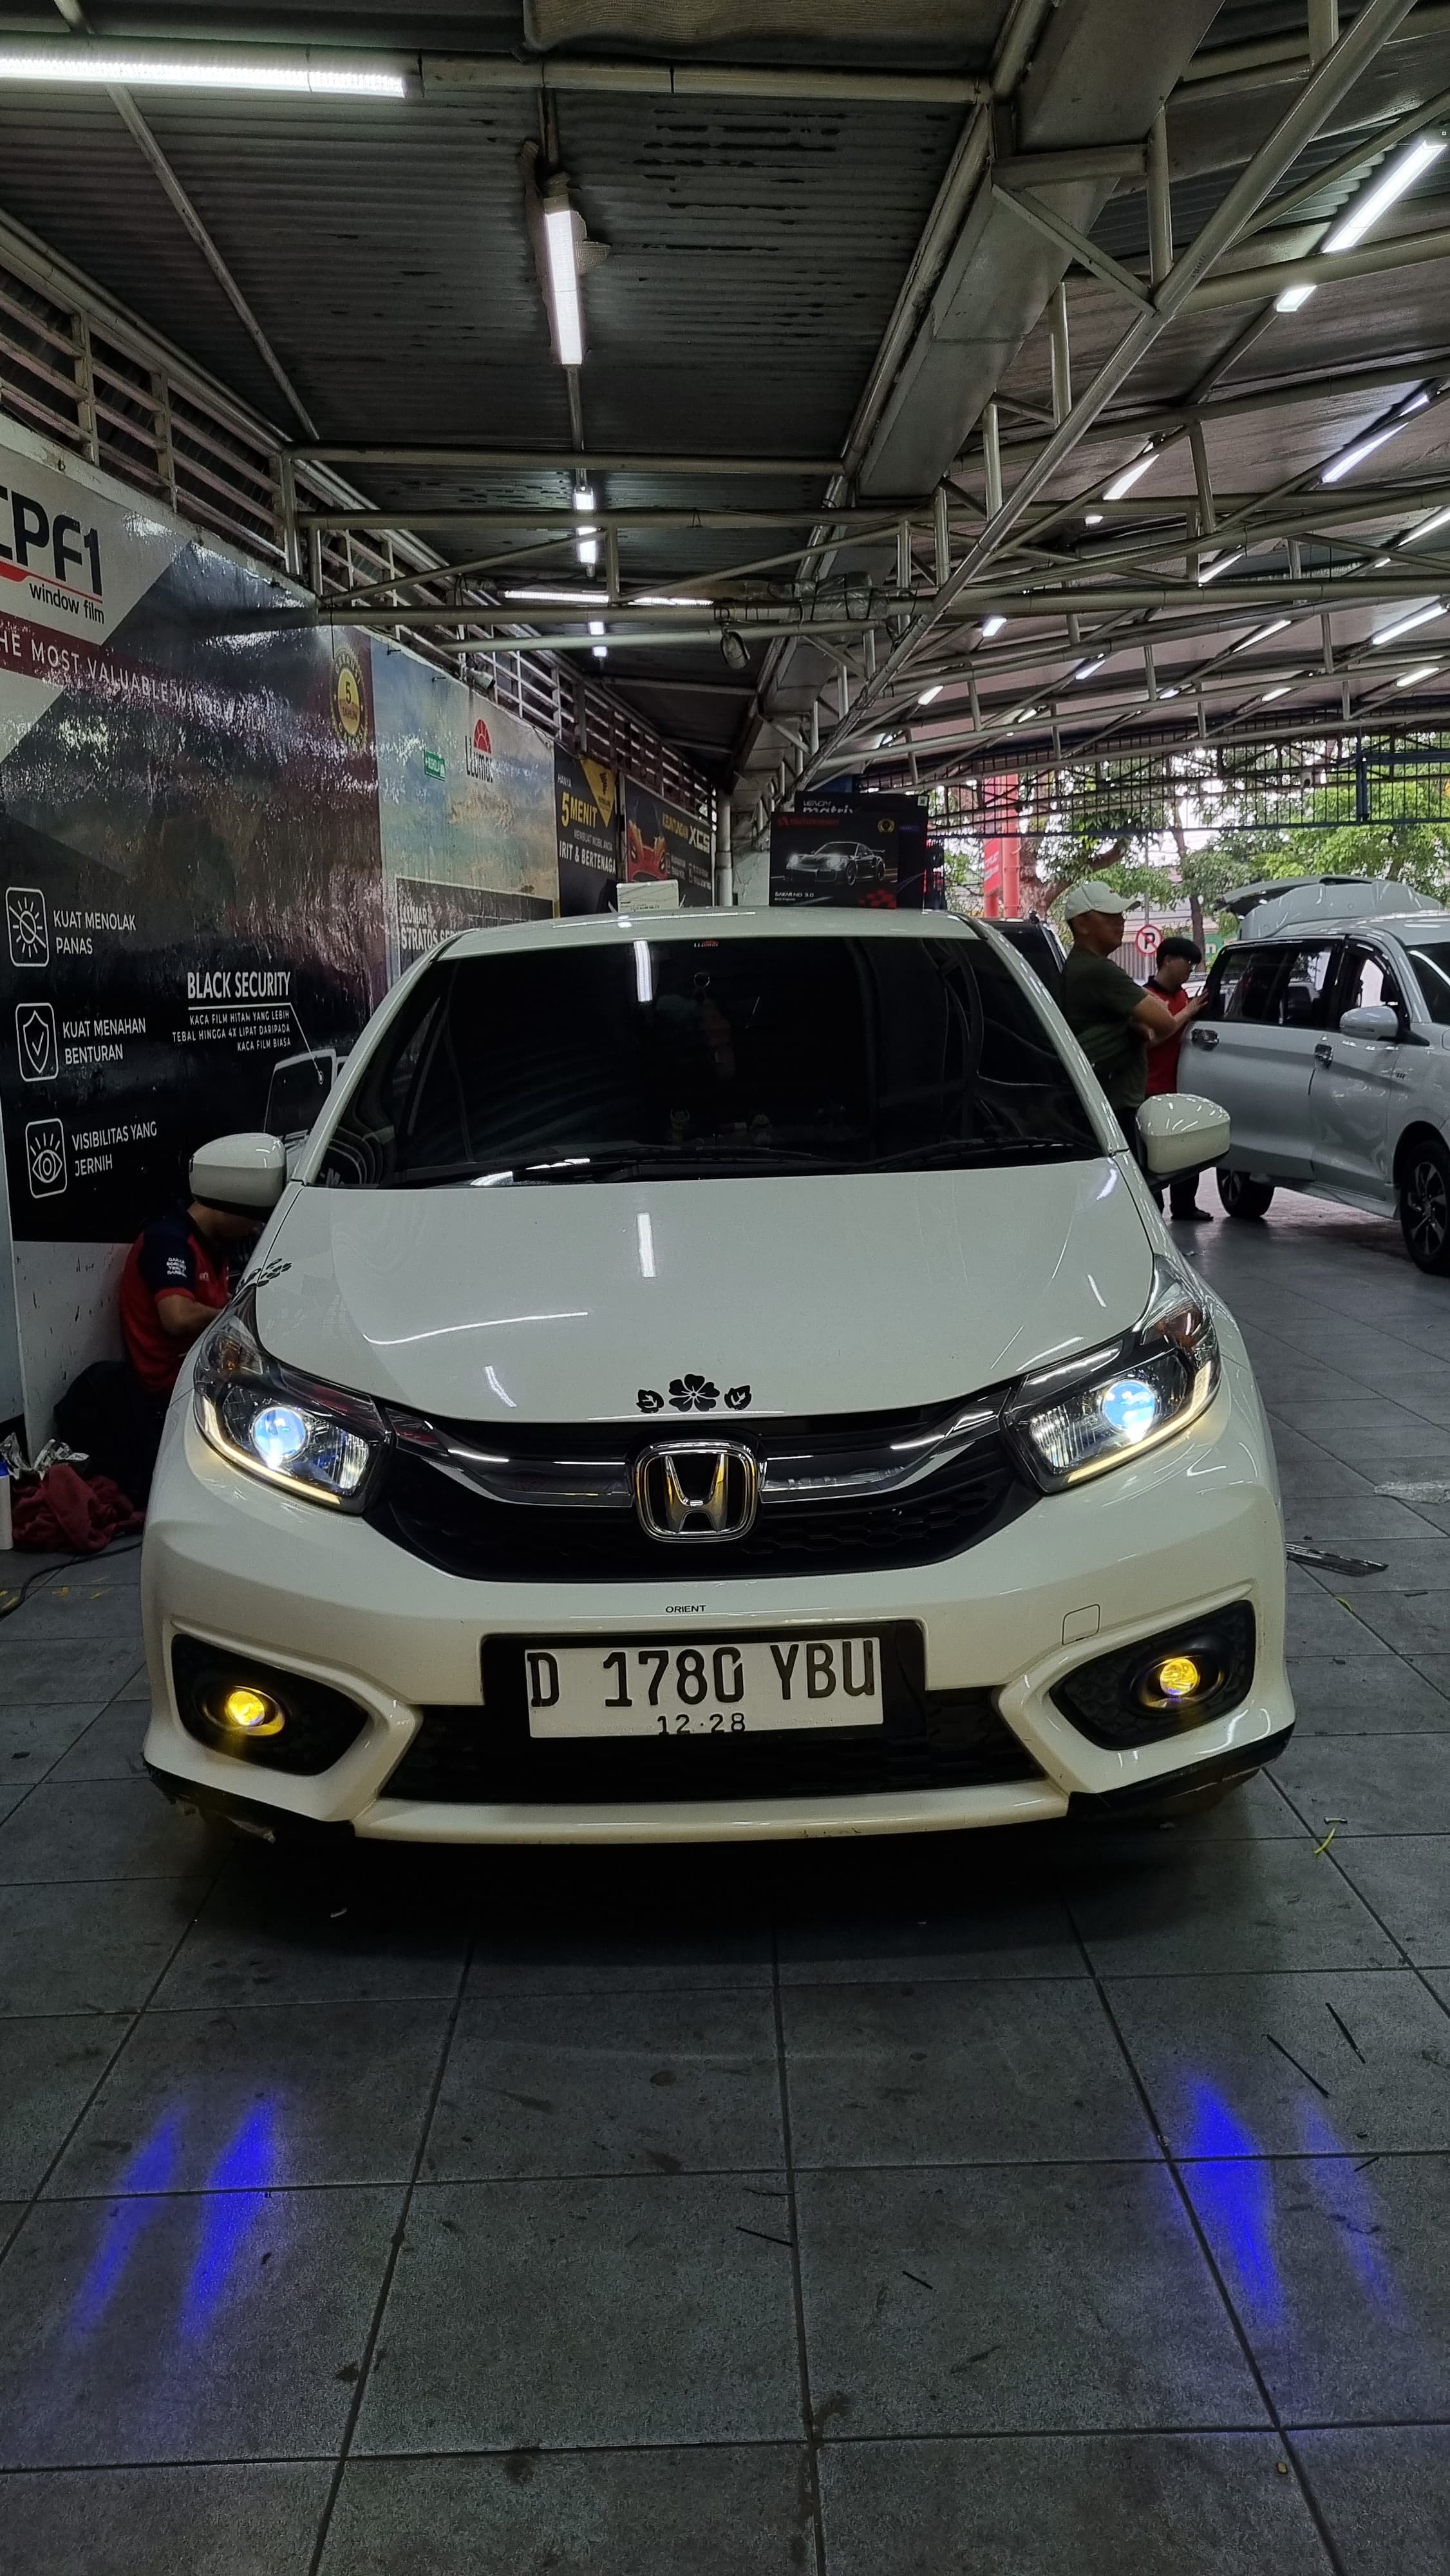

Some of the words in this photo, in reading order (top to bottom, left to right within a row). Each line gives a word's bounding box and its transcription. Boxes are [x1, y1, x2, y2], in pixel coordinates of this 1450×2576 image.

[30, 583, 79, 614] window
[84, 600, 104, 624] film
[32, 639, 79, 674] MOST
[88, 657, 169, 703] VALUABLE
[345, 681, 352, 704] 5
[558, 773, 572, 789] HANYA
[561, 791, 570, 828] 5
[570, 797, 598, 828] MENIT
[688, 825, 710, 854] XCS
[560, 840, 573, 861] IRIT
[581, 848, 616, 875] BERTENAGA
[53, 910, 82, 929] KUAT
[85, 911, 137, 931] MENOLAK
[56, 937, 93, 954] PANAS
[400, 926, 438, 950] STRATOS
[187, 971, 231, 999] BLACK
[235, 971, 290, 998] SECURITY
[63, 1020, 90, 1038] KUAT
[94, 1018, 146, 1036] MENAHAN
[190, 1014, 209, 1025] KACA
[212, 1013, 227, 1024] FILM
[231, 1012, 250, 1022] HITAM
[252, 1010, 269, 1021] YANG
[272, 1010, 289, 1019] LEBIH
[173, 1031, 196, 1042] TEBAL
[199, 1028, 225, 1041] HINGGA
[229, 1028, 237, 1037] 4X
[239, 1026, 256, 1037] LIPAT
[259, 1023, 290, 1035] DARIPADA
[238, 1041, 254, 1051] KACA
[257, 1039, 271, 1050] FILM
[273, 1037, 291, 1048] BIASA
[65, 1043, 123, 1065] BENTURAN
[72, 1126, 129, 1151] VISIBILITAS
[130, 1121, 156, 1141] YANG
[75, 1153, 113, 1177] JERNIH
[665, 1604, 707, 1613] ORIENT
[527, 1652, 560, 1707] D
[603, 1646, 744, 1707] 1780
[770, 1640, 875, 1700] YBU
